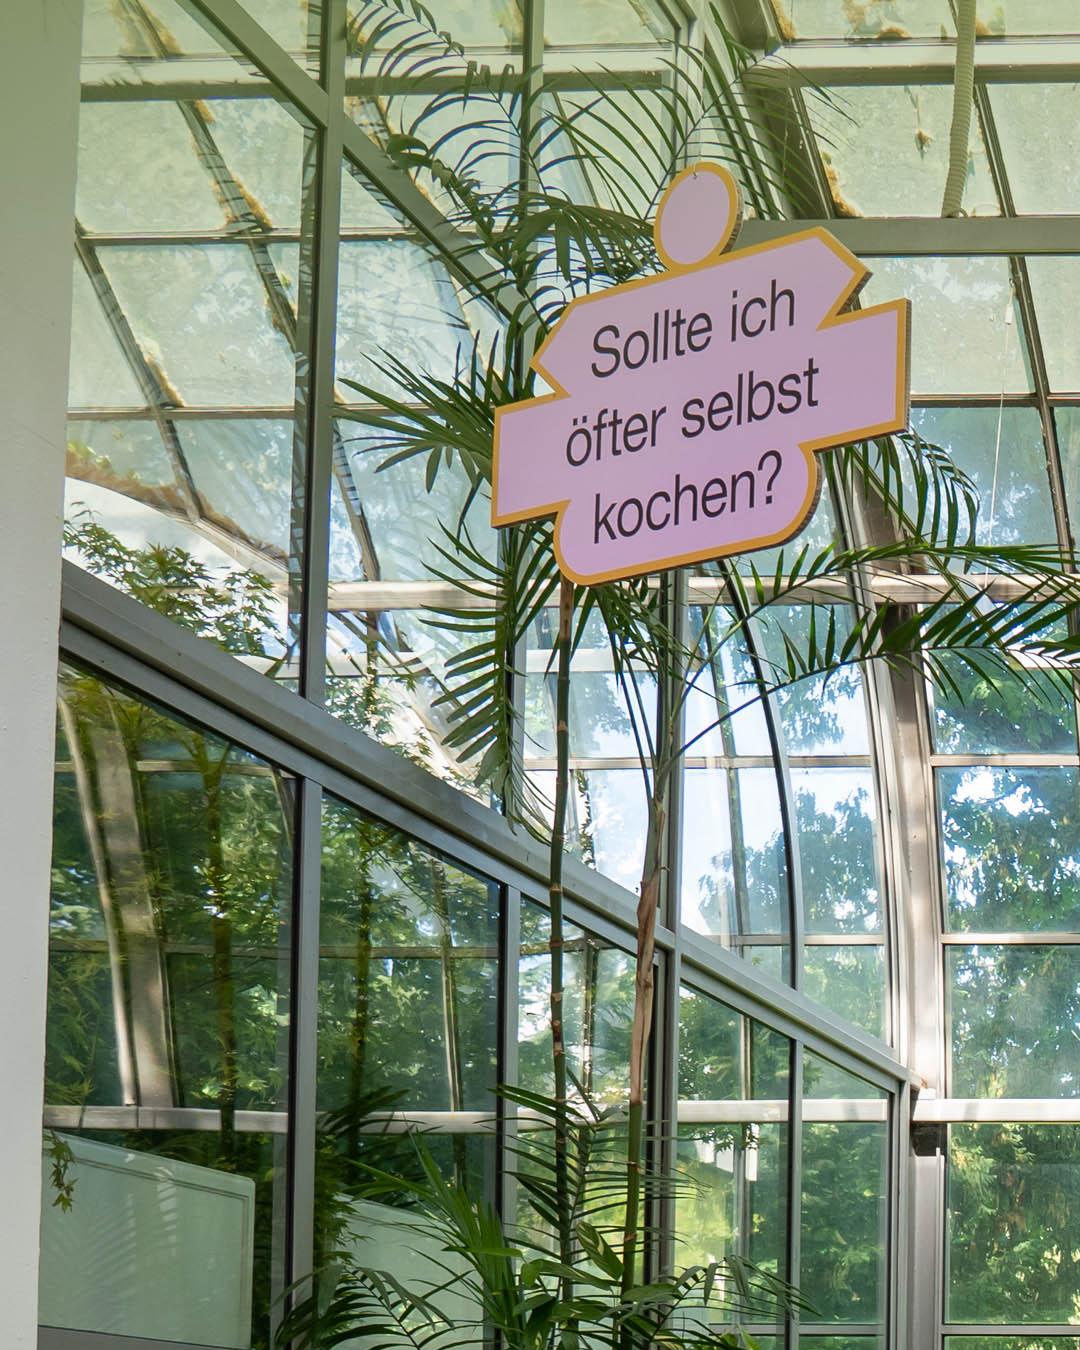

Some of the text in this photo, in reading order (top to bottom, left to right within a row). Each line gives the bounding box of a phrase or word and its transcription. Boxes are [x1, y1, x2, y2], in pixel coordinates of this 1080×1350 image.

[590, 279, 795, 378] Sollte ich
[566, 358, 819, 467] öfter selbst
[593, 450, 783, 544] kochen?
